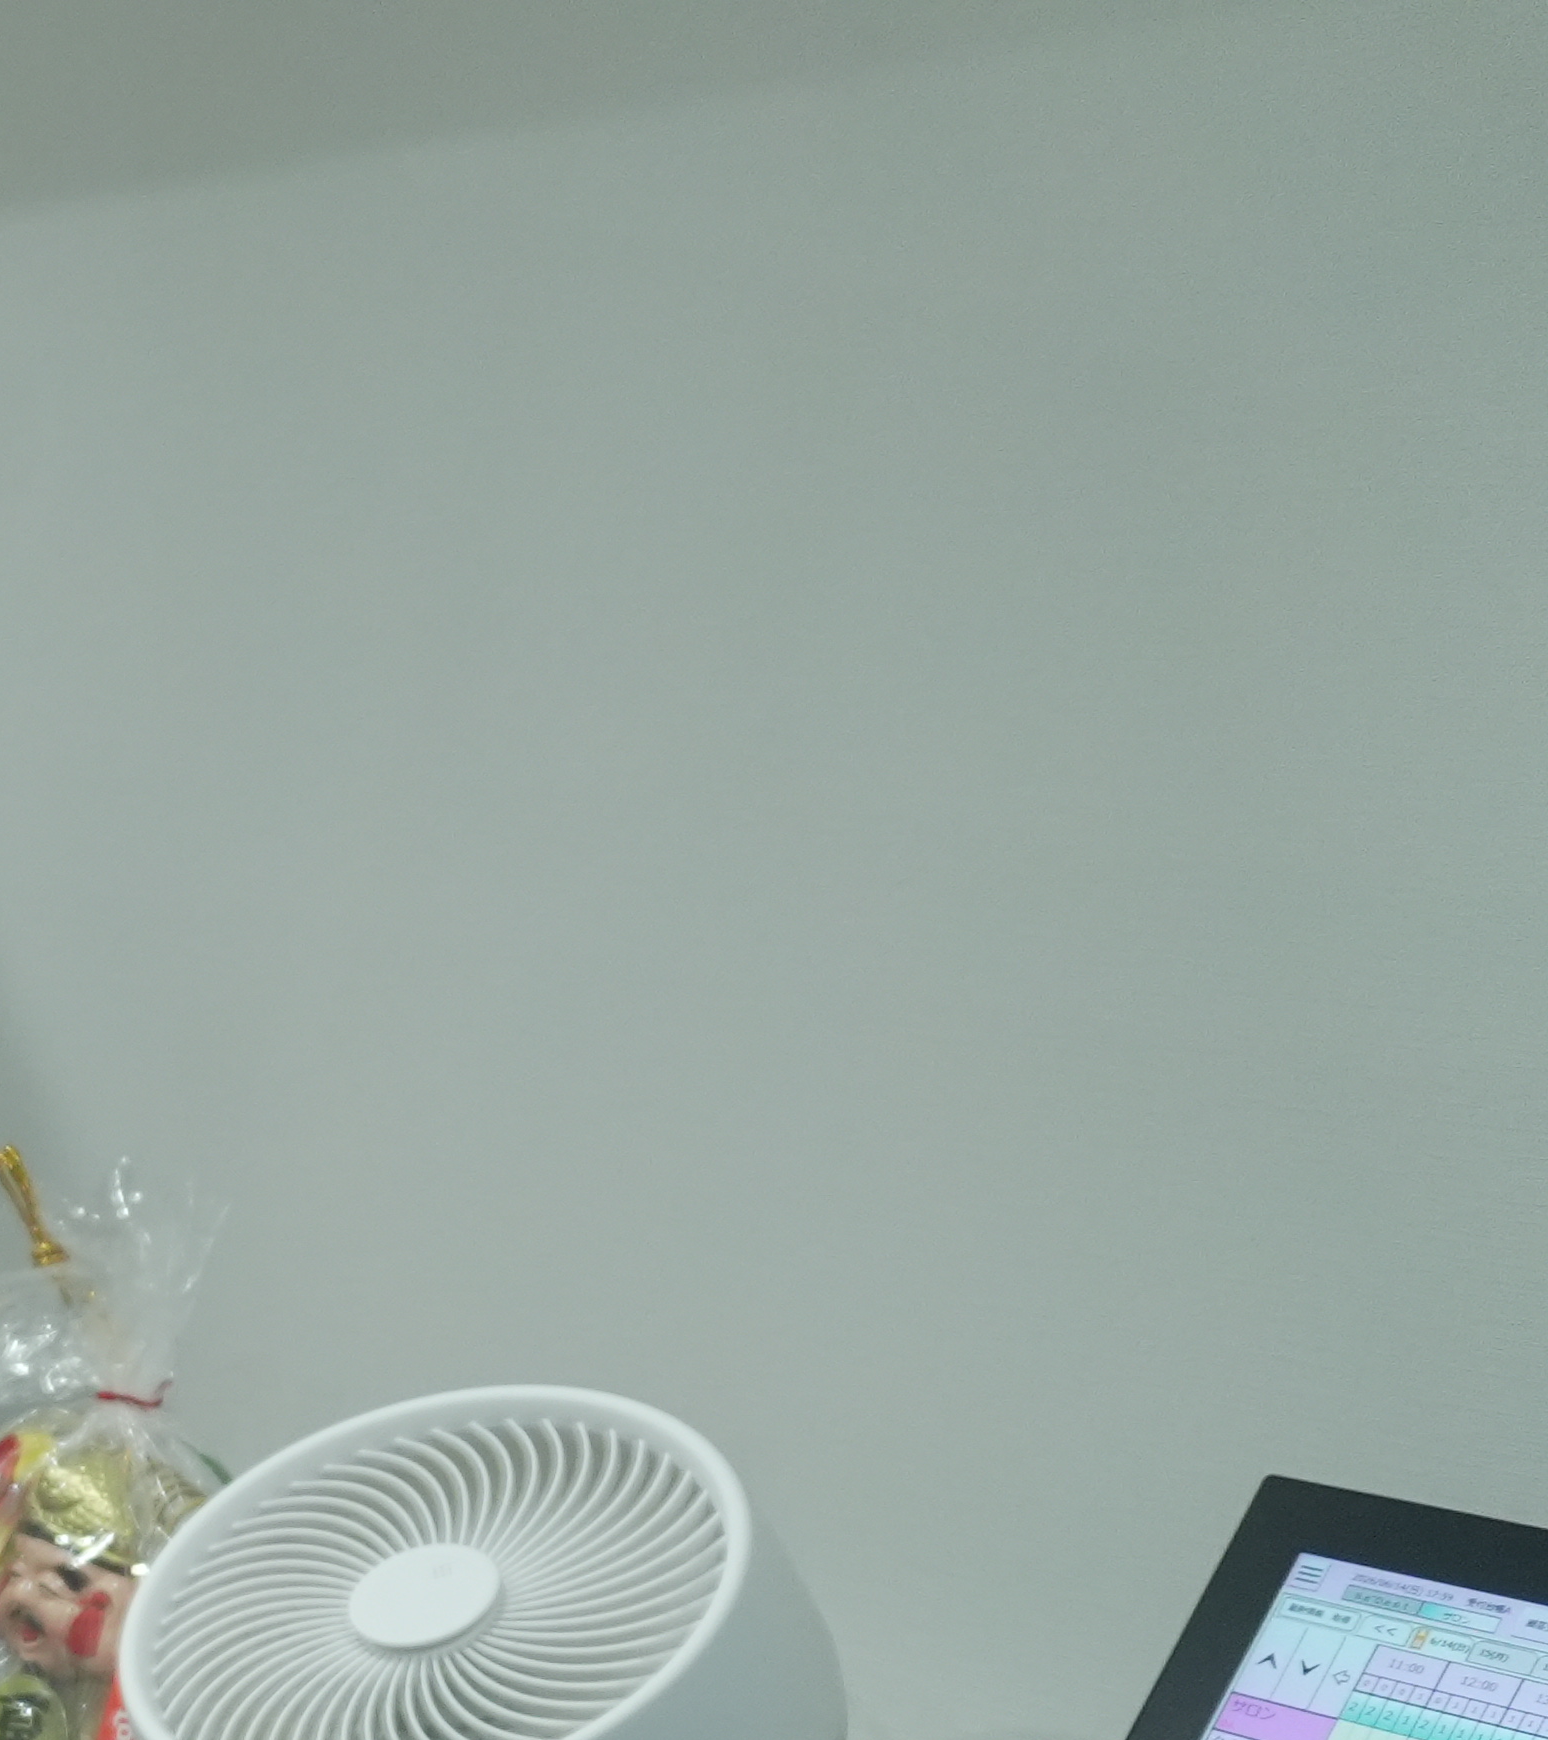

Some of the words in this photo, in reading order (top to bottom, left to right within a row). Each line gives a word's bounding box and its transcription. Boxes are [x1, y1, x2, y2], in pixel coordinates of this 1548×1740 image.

[1386, 1658, 1426, 1676] 11:00
[1459, 1675, 1500, 1693] 12:00
[1232, 1699, 1277, 1720] サロン
